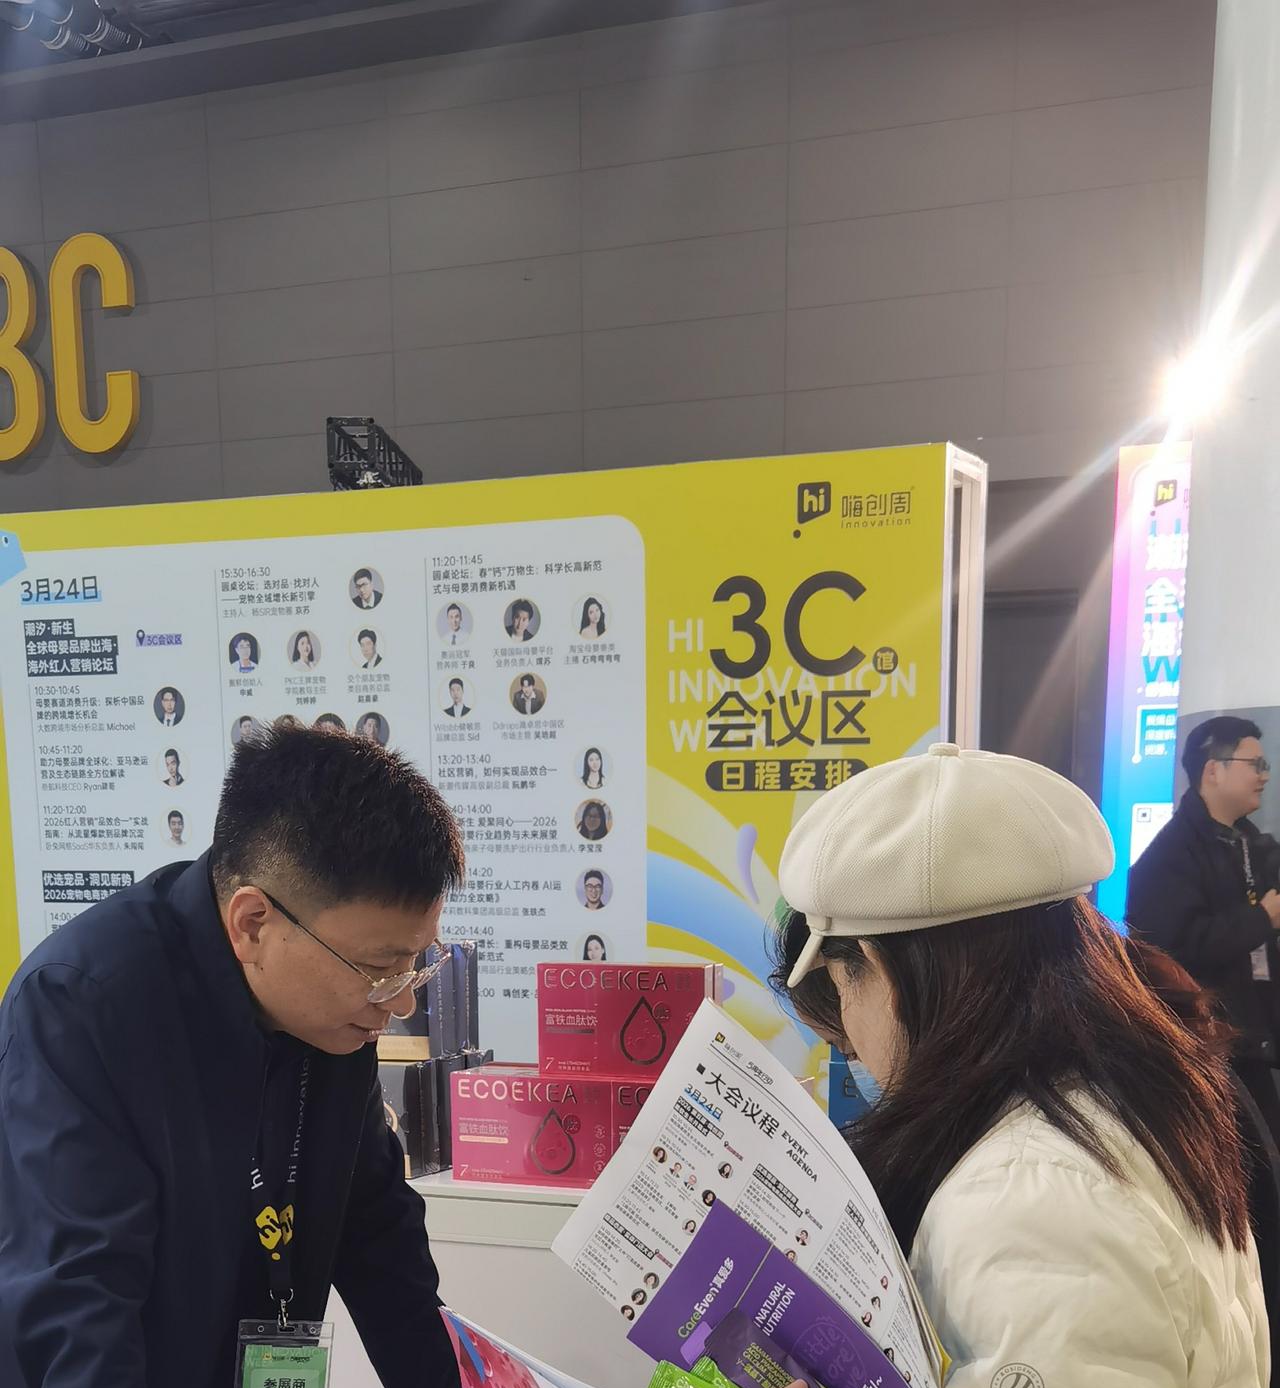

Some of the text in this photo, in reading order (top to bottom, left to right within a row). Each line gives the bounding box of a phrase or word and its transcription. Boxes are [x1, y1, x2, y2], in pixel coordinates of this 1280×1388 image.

[803, 488, 826, 513] hi
[841, 491, 912, 519] 嗨创周
[841, 517, 912, 529] innovation
[220, 567, 274, 579] 15:30-16:30
[432, 555, 483, 567] 11:20-11:45
[20, 575, 99, 602] 3月24日
[668, 618, 703, 653] HI
[709, 570, 867, 679] 3C
[146, 634, 182, 646] 3C会议区
[28, 657, 114, 674] 海外红人营销论坛
[35, 685, 80, 695] 10:30-10:45
[706, 689, 871, 748] 会议区
[39, 745, 83, 755] 10:45-11:20
[438, 754, 491, 765] 13:20-13:40
[722, 761, 852, 790] 日程安排
[43, 805, 87, 814] 11:20-12:00
[44, 889, 123, 900] 2026宠物电商选品
[441, 925, 494, 936] 14:20-14:40
[543, 968, 668, 992] ECOEKEA
[545, 1014, 598, 1027] 富铁血肽饮
[457, 1079, 577, 1104] ECOEKEA
[684, 1083, 723, 1120] 3月24日
[705, 1071, 780, 1139] 大会议程
[781, 1130, 818, 1183] EVENT AGENDA
[460, 1164, 469, 1177] 7
[678, 1286, 719, 1339] CareEven
[755, 1280, 787, 1328] NATURAL
